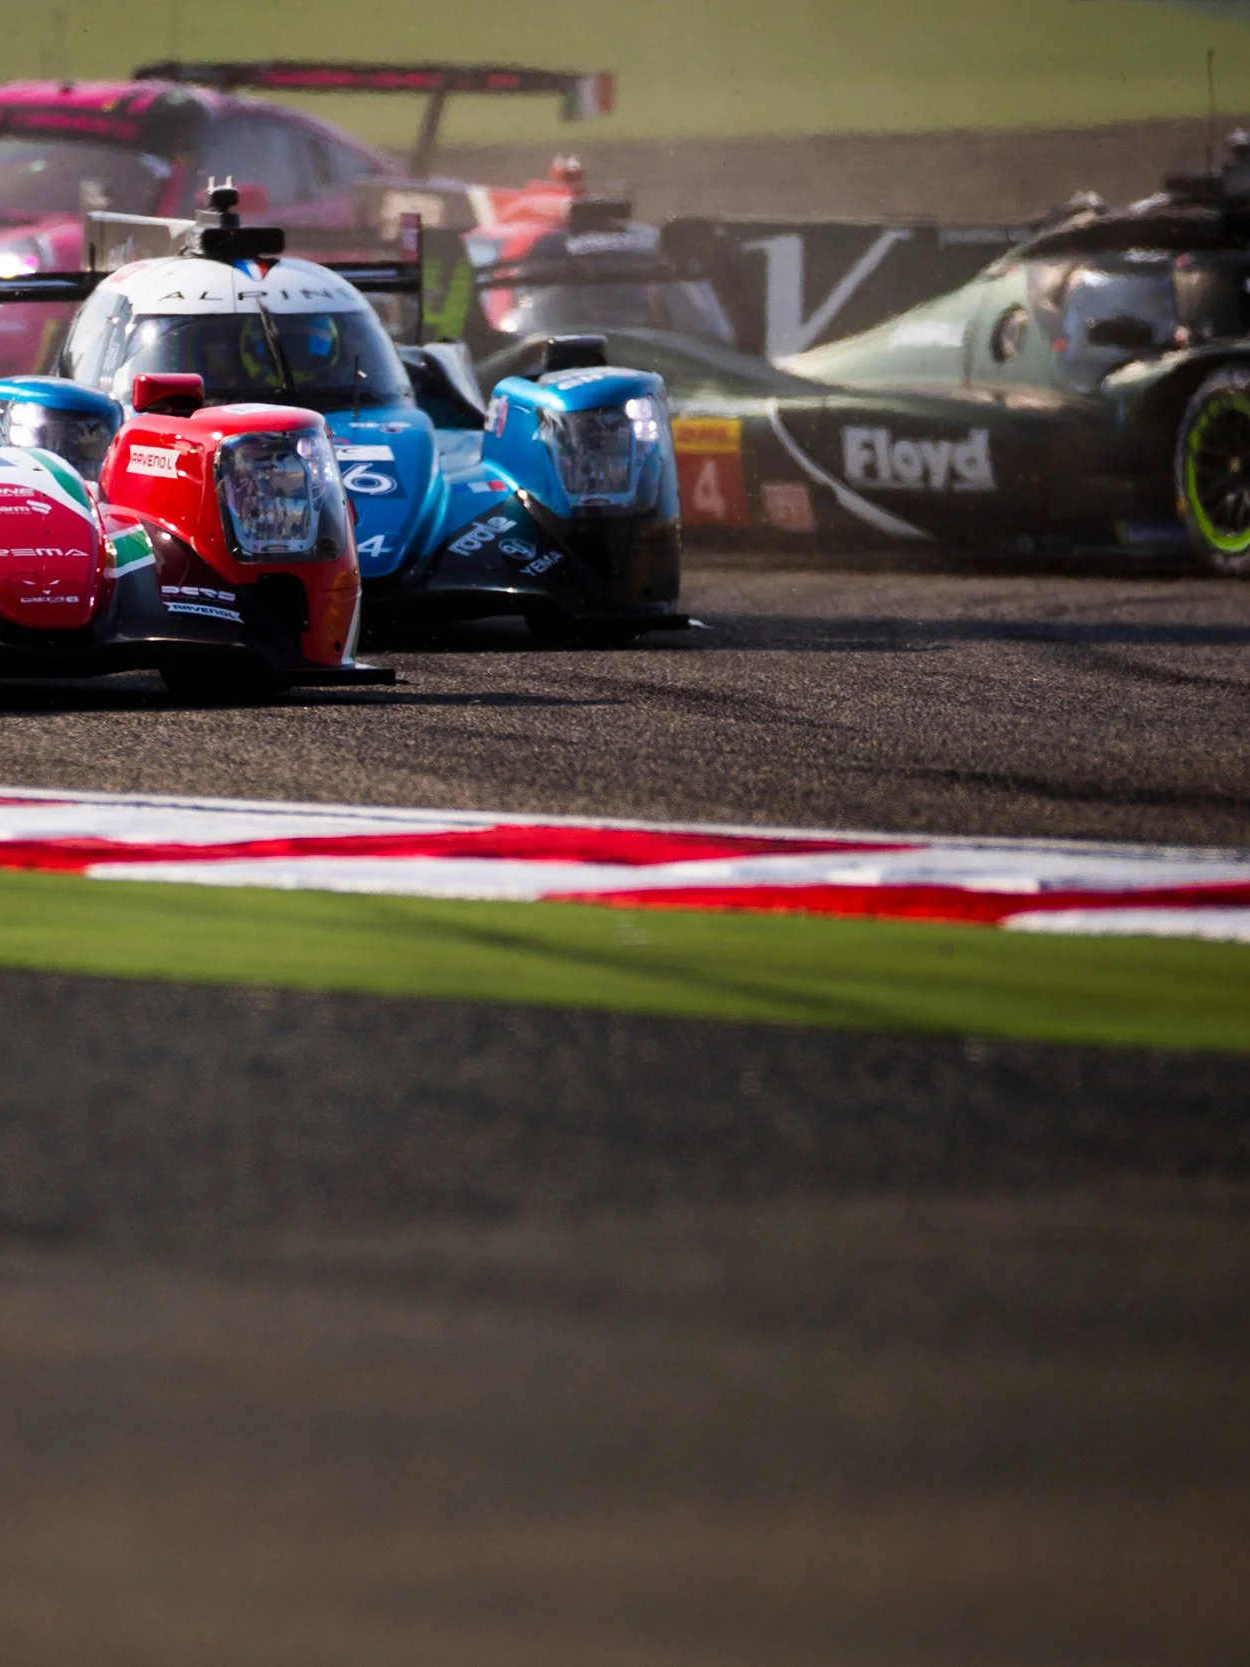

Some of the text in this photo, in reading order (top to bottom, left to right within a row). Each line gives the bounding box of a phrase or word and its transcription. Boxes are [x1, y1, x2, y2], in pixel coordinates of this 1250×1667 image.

[132, 452, 173, 470] RAVENOL
[841, 426, 996, 492] Floyd
[692, 458, 727, 521] 4
[172, 604, 238, 619] RAVENOL
